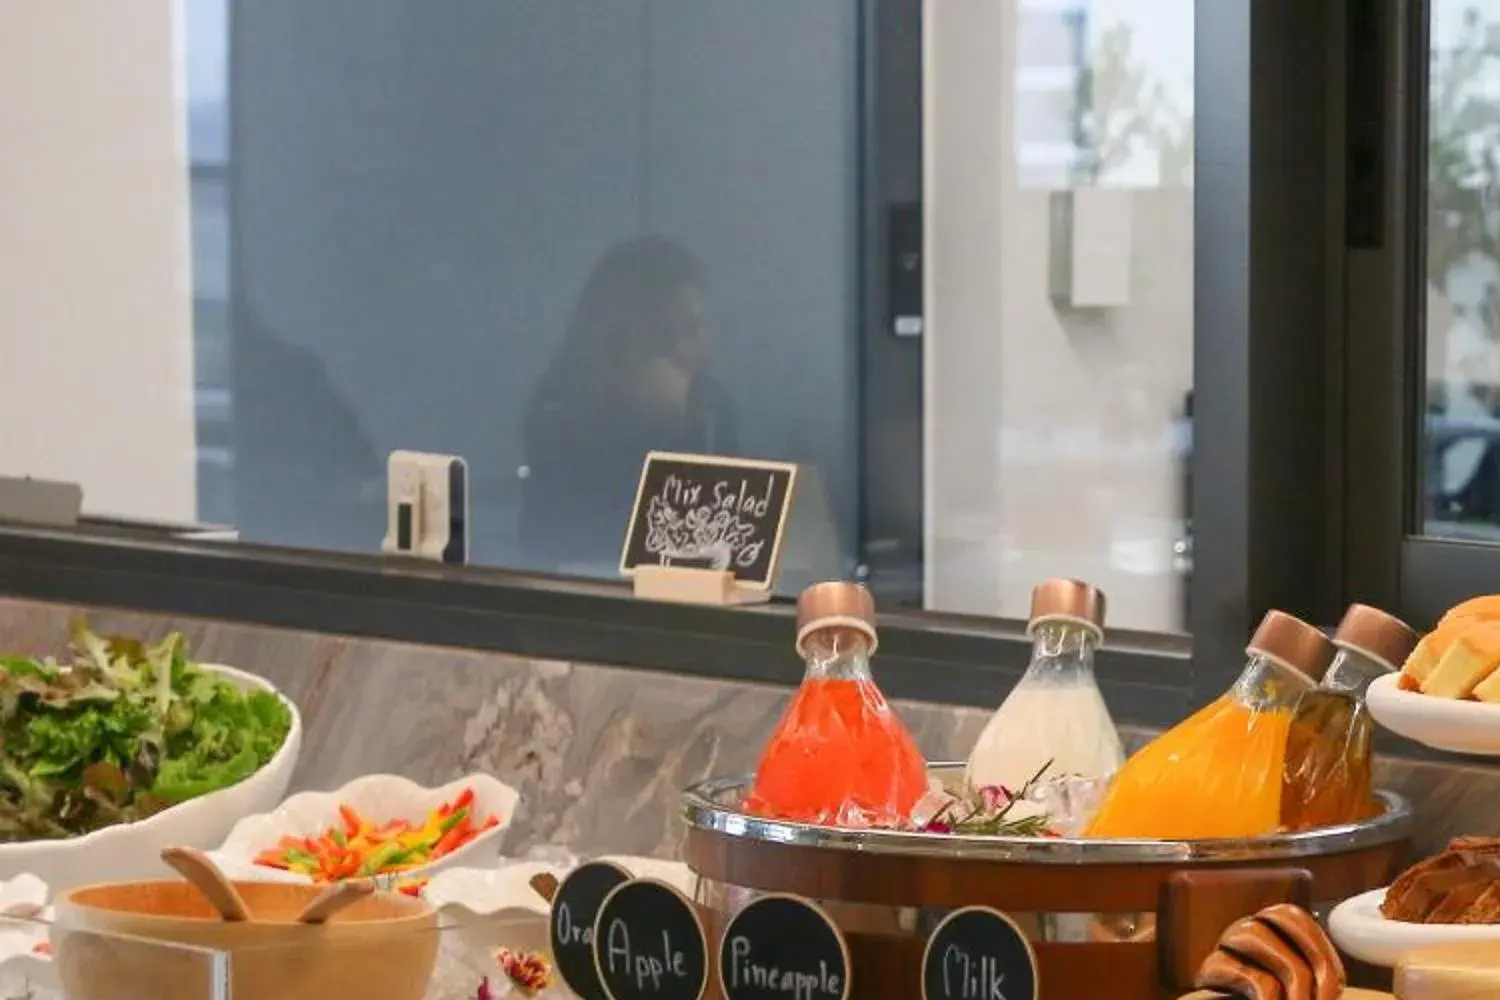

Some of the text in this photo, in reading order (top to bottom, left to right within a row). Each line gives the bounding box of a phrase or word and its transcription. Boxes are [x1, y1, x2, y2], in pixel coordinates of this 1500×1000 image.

[663, 472, 775, 517] Mix Salad
[607, 917, 688, 991] Apple
